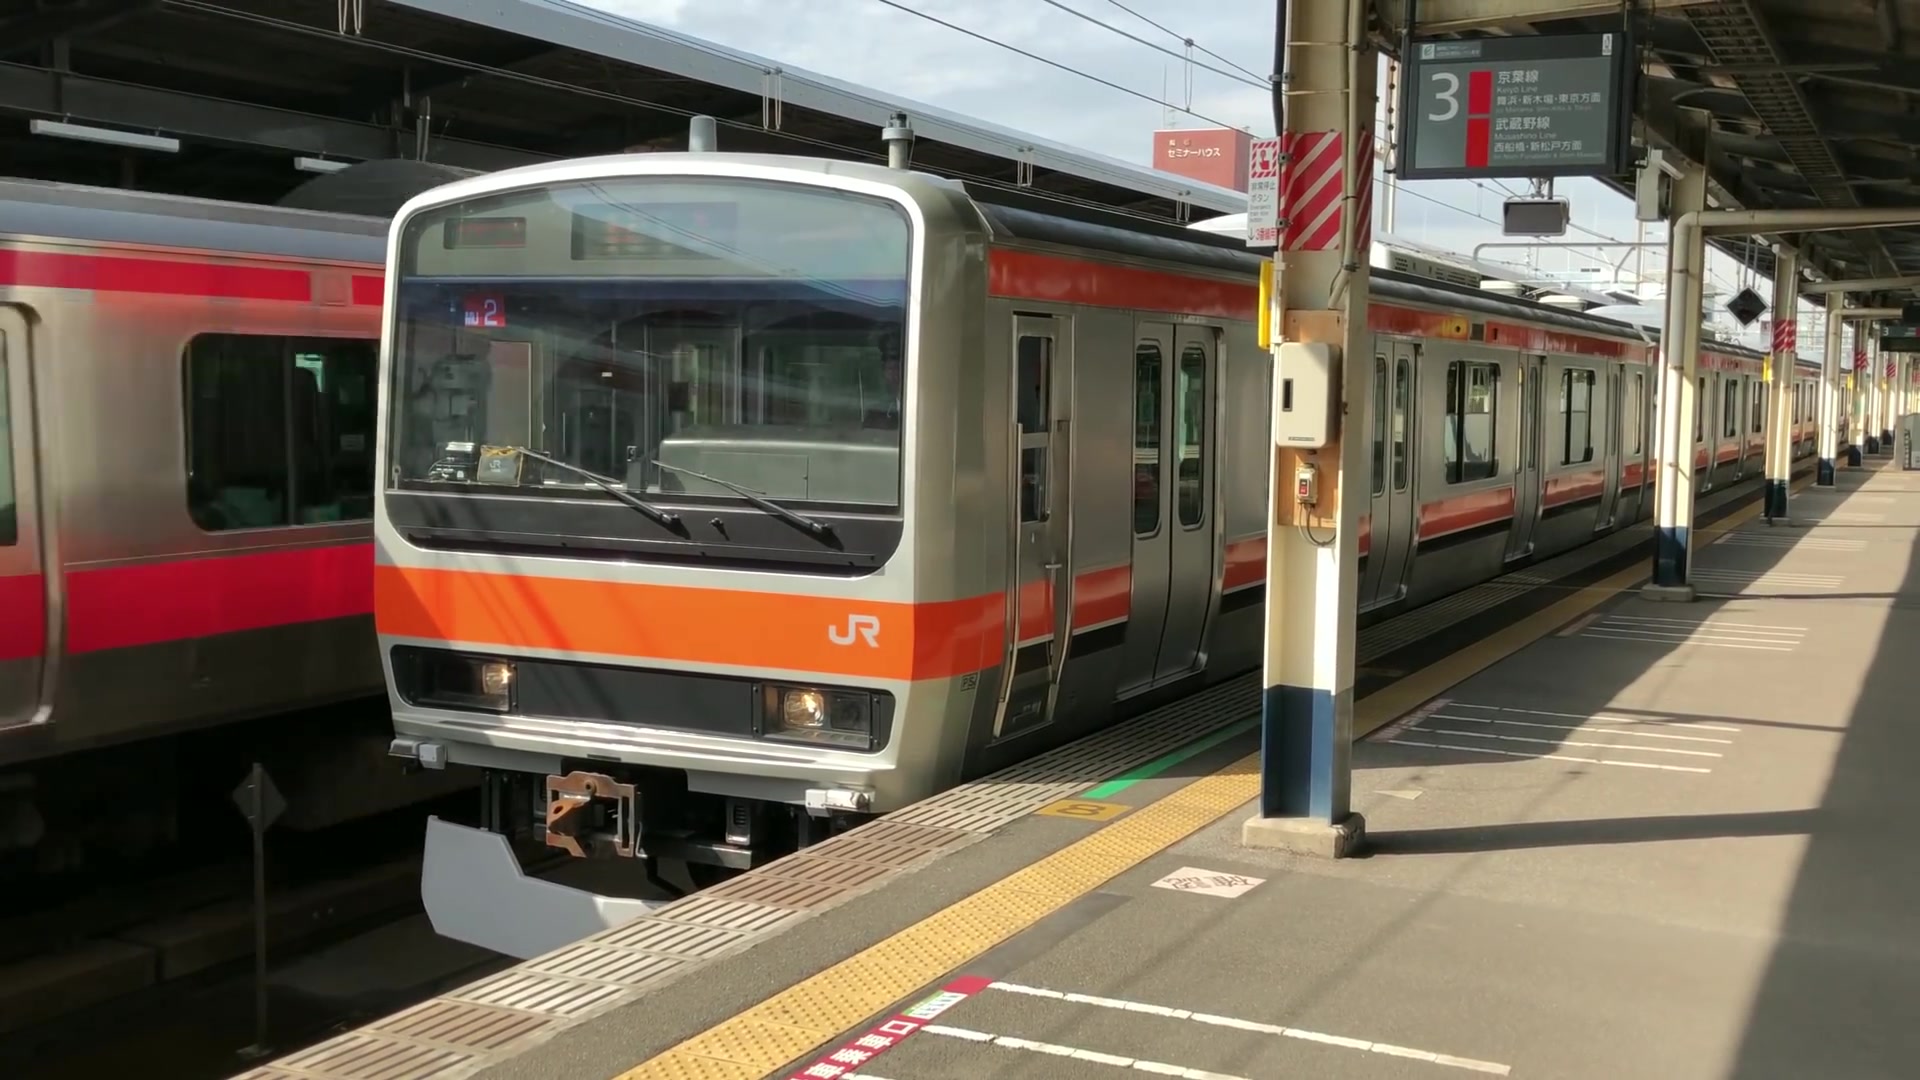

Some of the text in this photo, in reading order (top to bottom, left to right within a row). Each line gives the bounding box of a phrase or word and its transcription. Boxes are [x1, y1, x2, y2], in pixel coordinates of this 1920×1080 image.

[1498, 70, 1539, 84] 京葉線
[1429, 72, 1460, 121] 3
[1495, 116, 1550, 131] 武蔵野線
[1168, 147, 1221, 158] セミナーハウス
[484, 299, 498, 326] 2
[1882, 327, 1889, 336] 3
[828, 614, 880, 648] JR
[790, 1020, 919, 1080] 車乗車口
